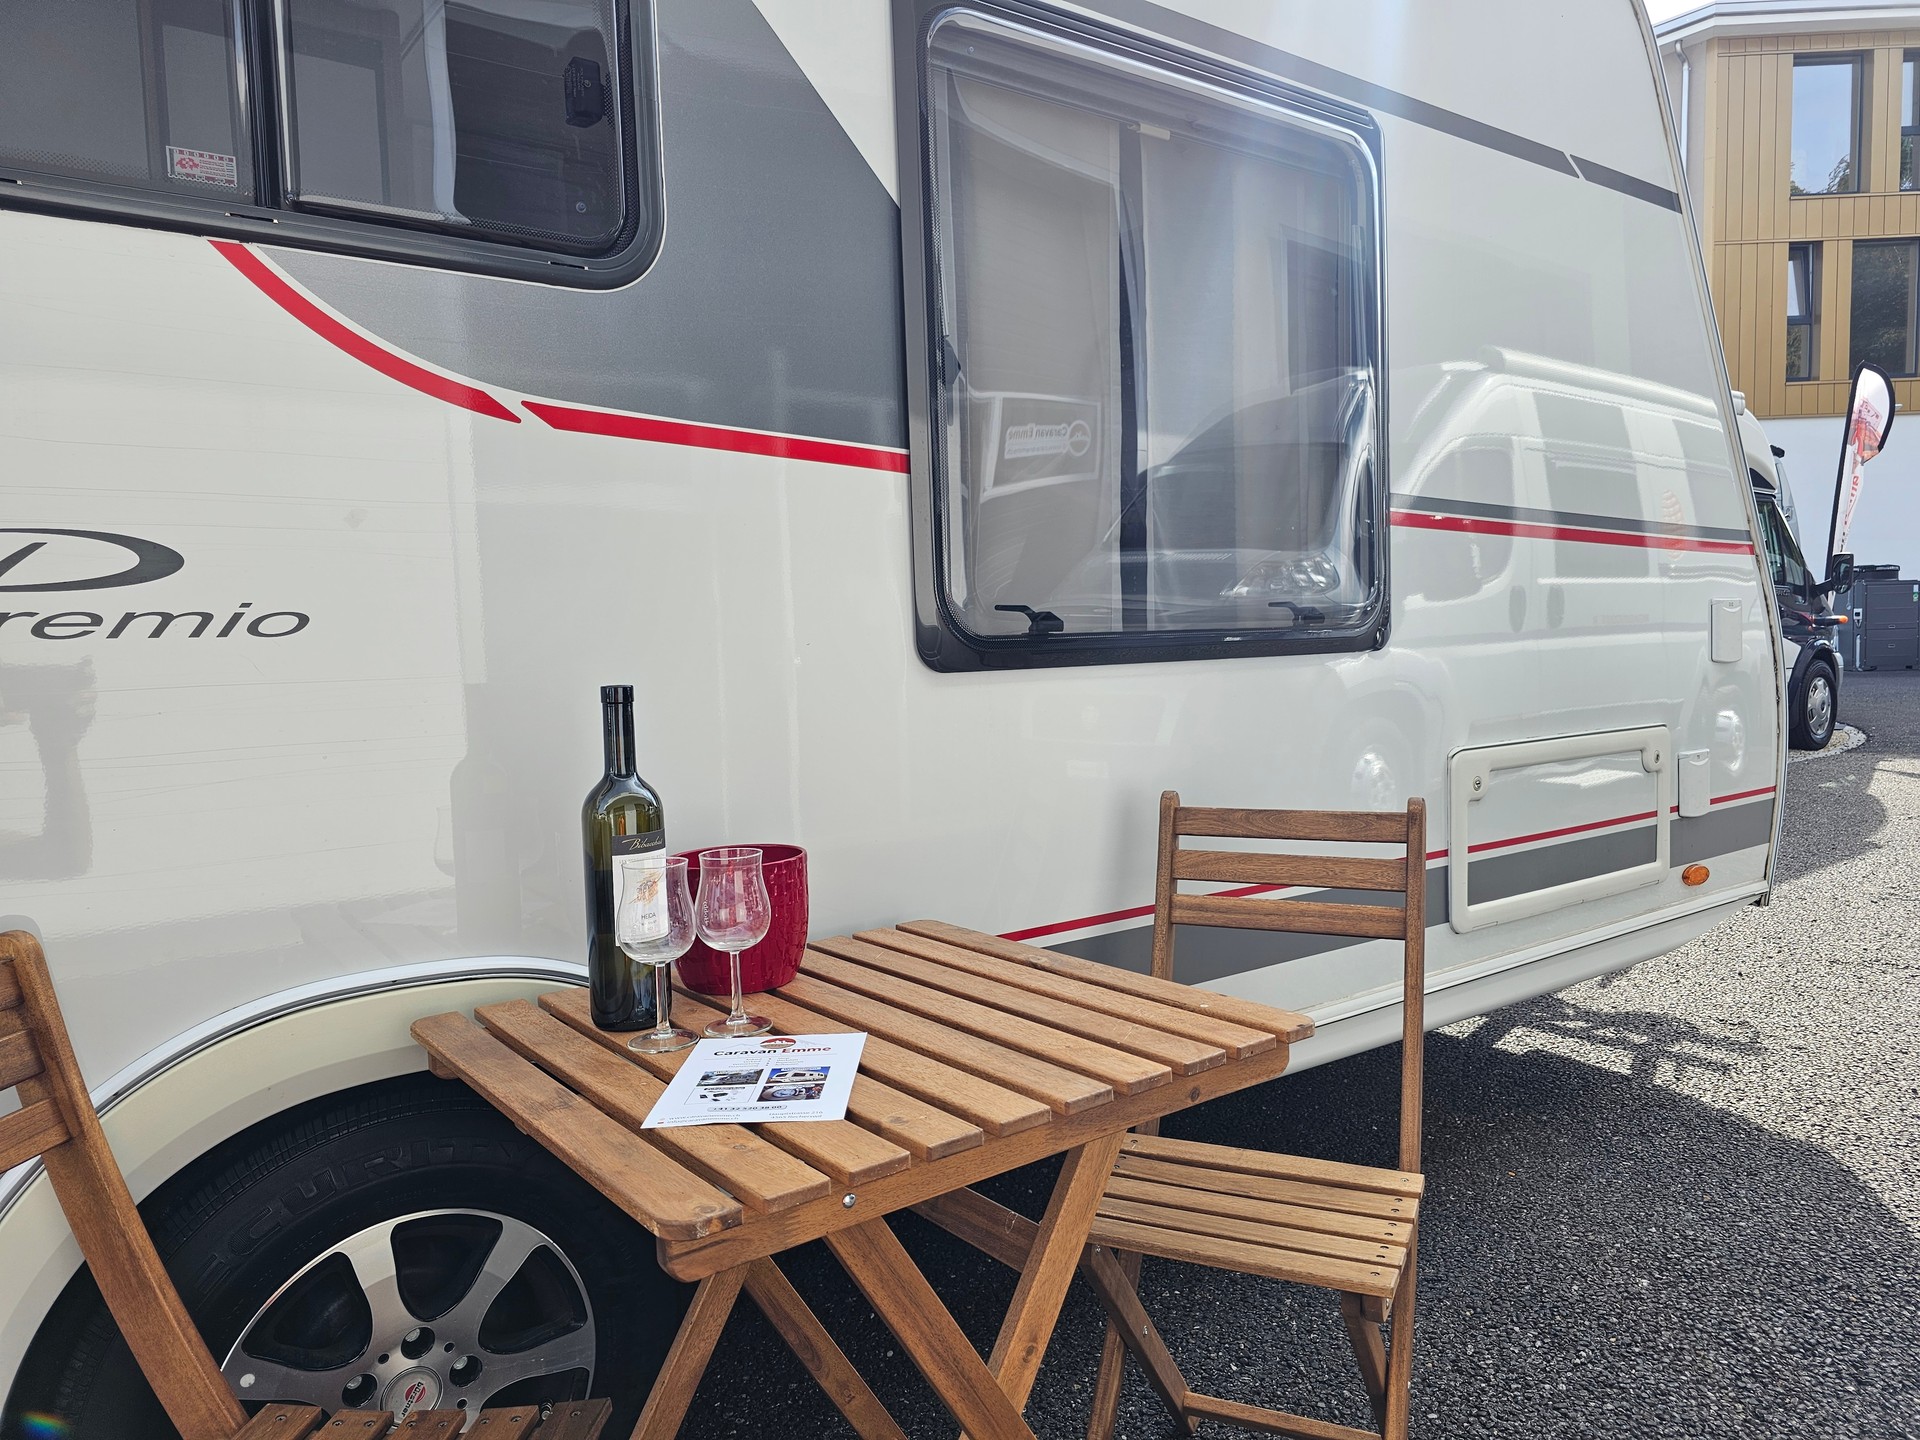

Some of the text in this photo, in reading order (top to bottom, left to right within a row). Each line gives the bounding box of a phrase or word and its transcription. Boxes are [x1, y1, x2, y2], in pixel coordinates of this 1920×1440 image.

[641, 912, 656, 920] HEIDA
[713, 1046, 832, 1056] Caravan Emme
[192, 1134, 543, 1298] ECURITY
